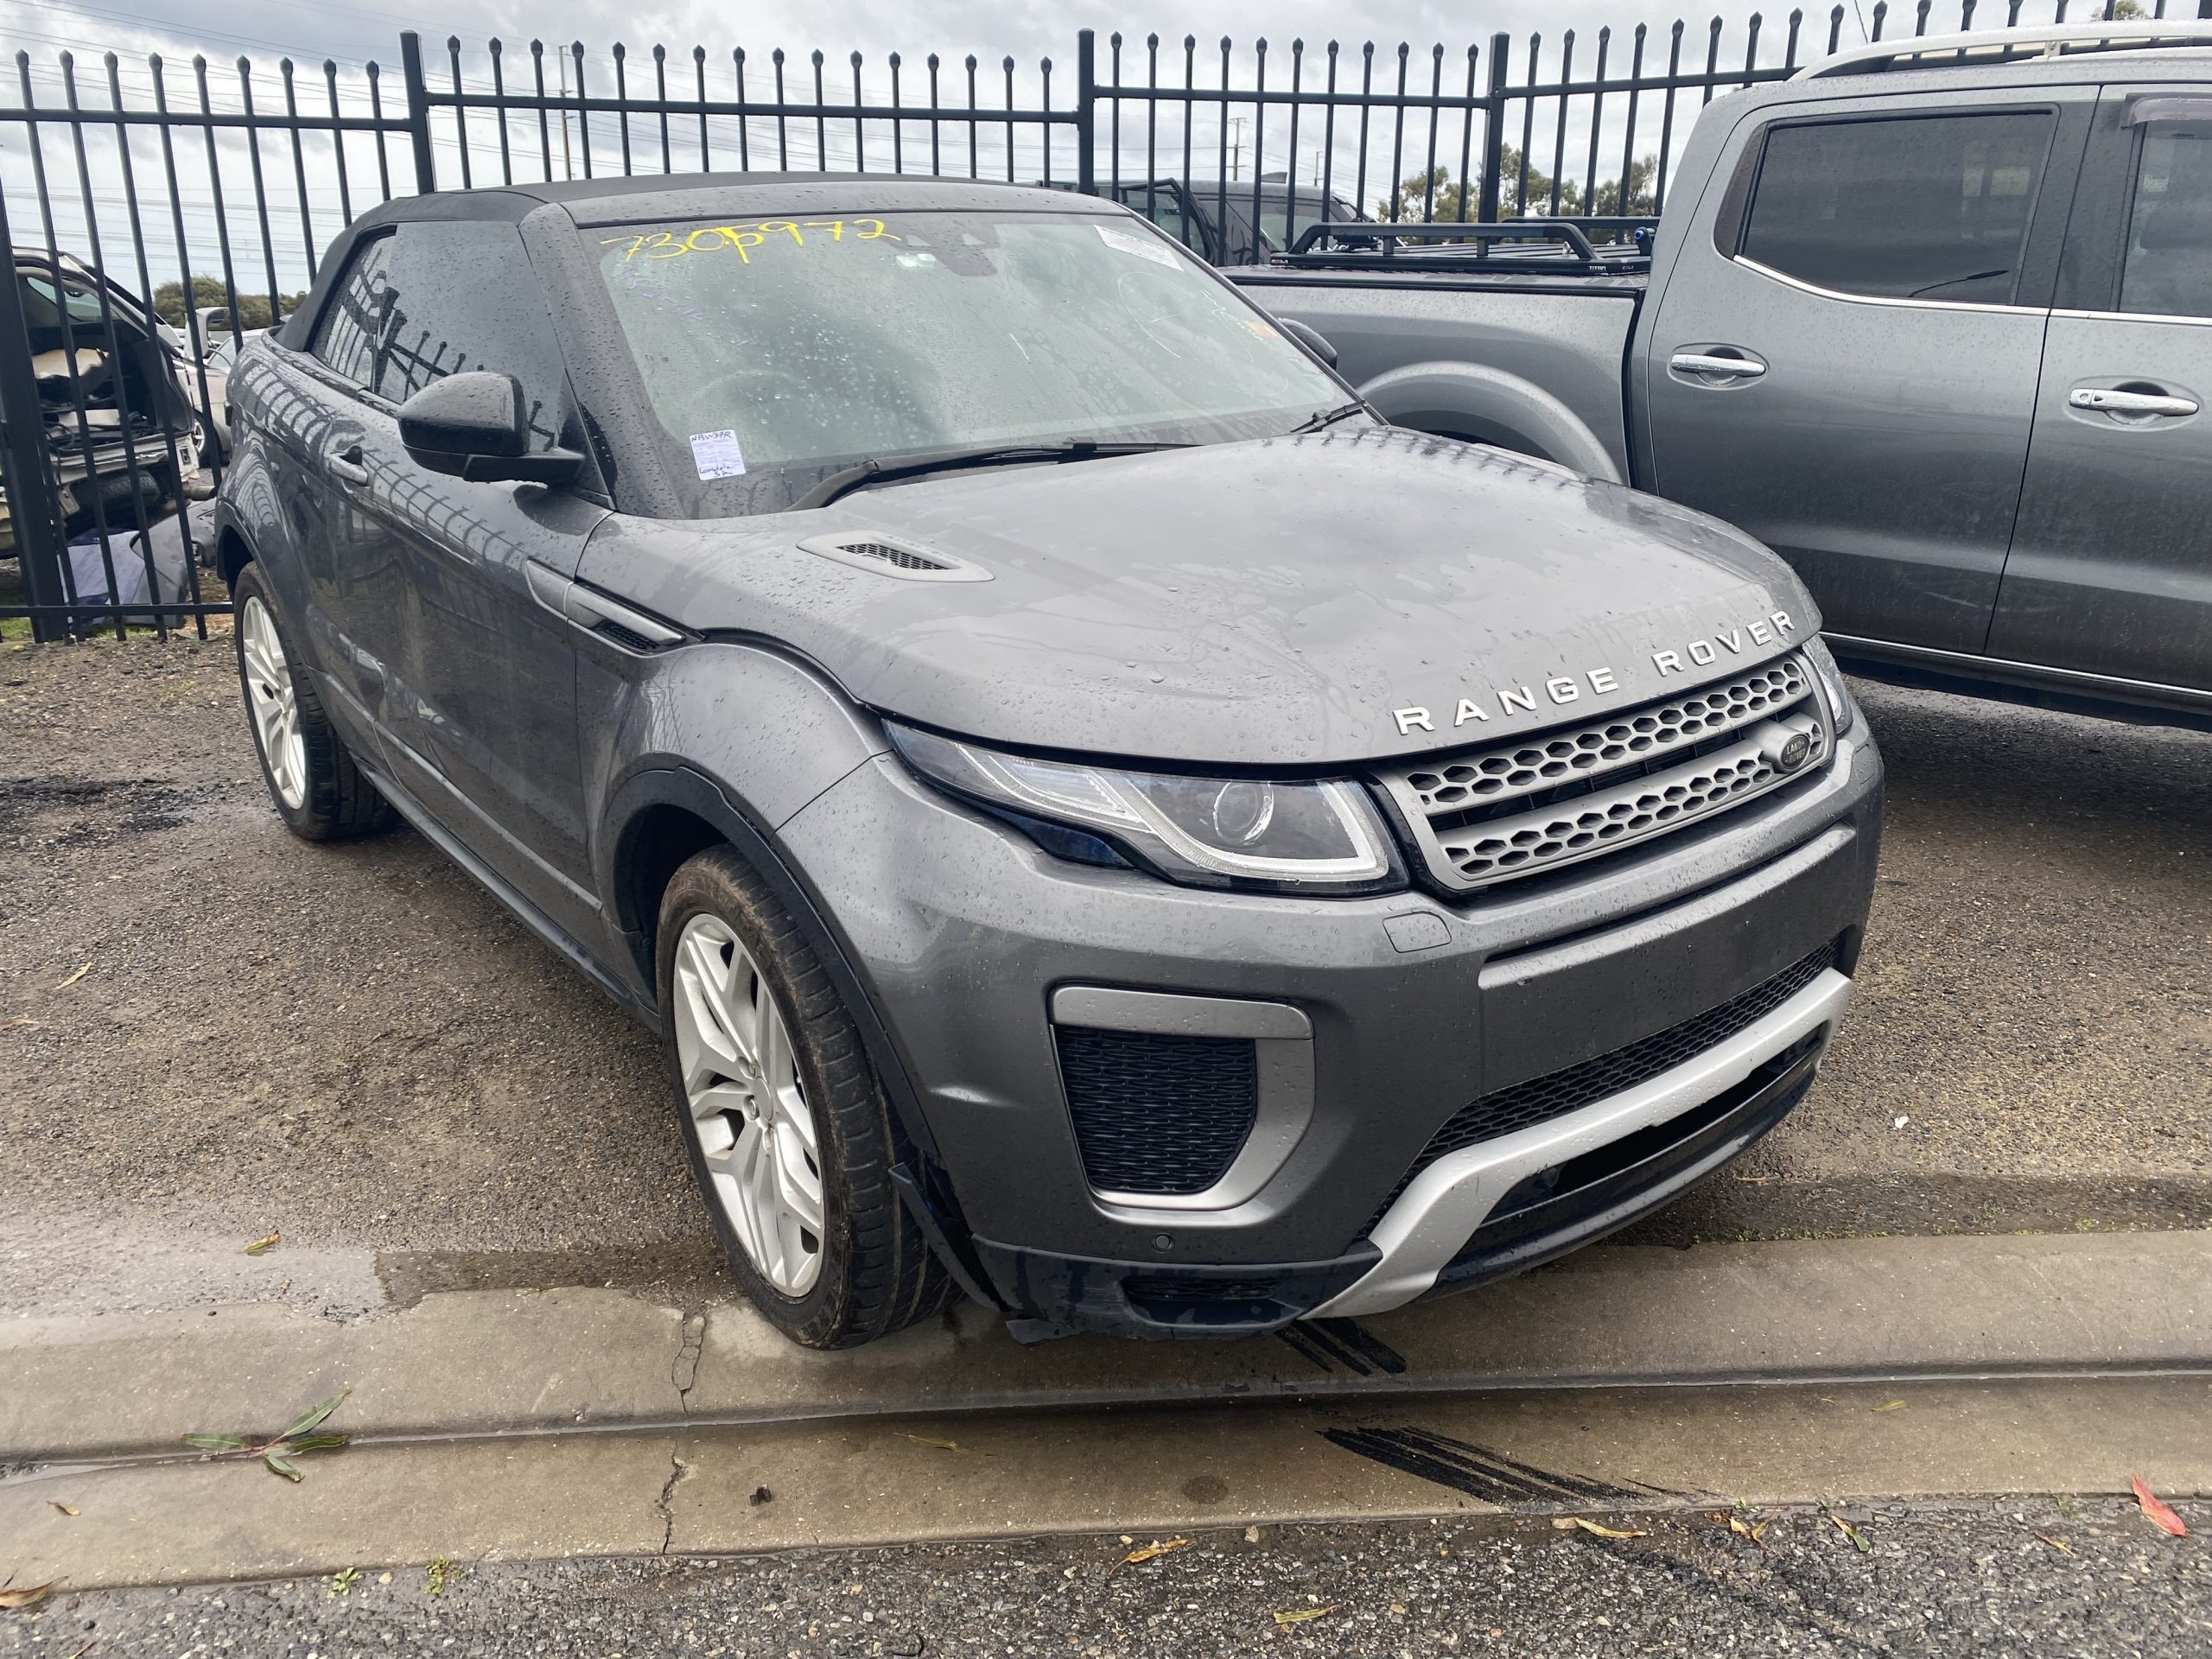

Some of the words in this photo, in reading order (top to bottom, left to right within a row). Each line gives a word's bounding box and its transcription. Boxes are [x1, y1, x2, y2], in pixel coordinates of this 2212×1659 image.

[1392, 666, 1619, 736] RANGE
[1651, 609, 1796, 677] ROVER
[1786, 740, 1802, 755] LAND
